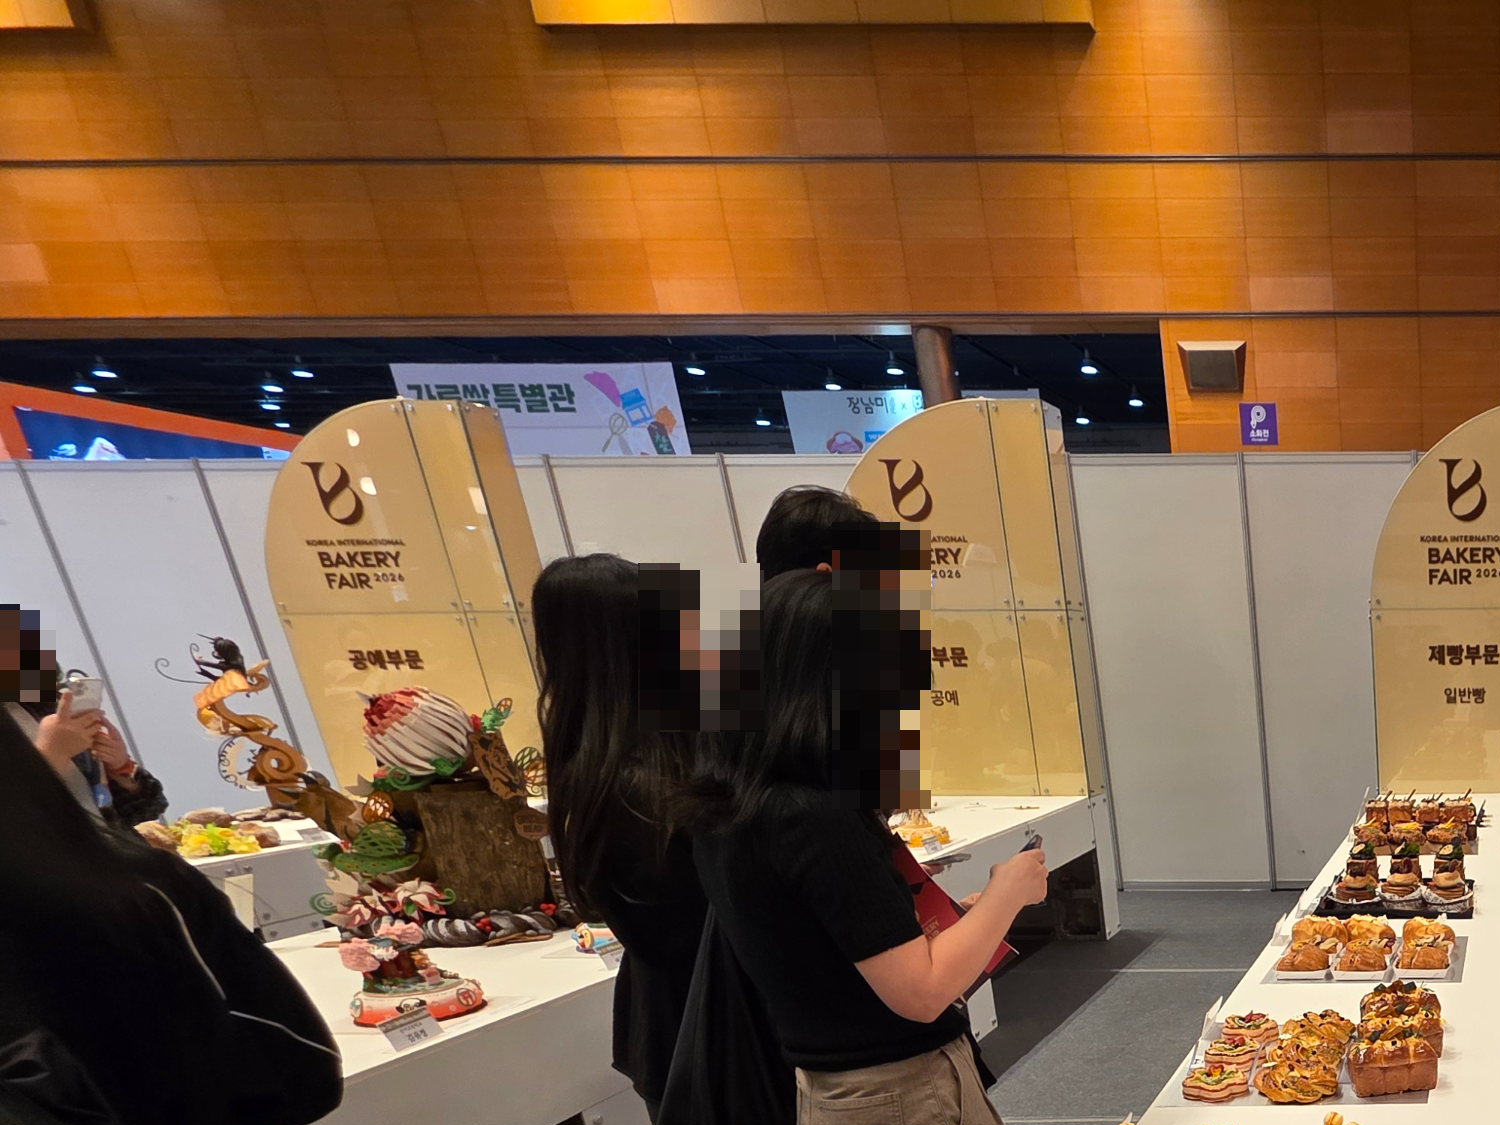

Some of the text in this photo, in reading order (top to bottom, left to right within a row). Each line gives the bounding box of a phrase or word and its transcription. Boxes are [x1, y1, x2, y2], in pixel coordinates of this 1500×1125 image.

[337, 538, 406, 546] INTERNATIONAL
[1420, 535, 1449, 543] KOREA
[317, 551, 401, 568] BAKERY
[324, 572, 405, 589] FAIR 2026
[931, 570, 961, 579] 2026
[1428, 568, 1472, 585] FAIR
[348, 650, 424, 670] 공예부문
[1428, 644, 1500, 665] 제빵부문
[1444, 687, 1486, 704] 일반빵
